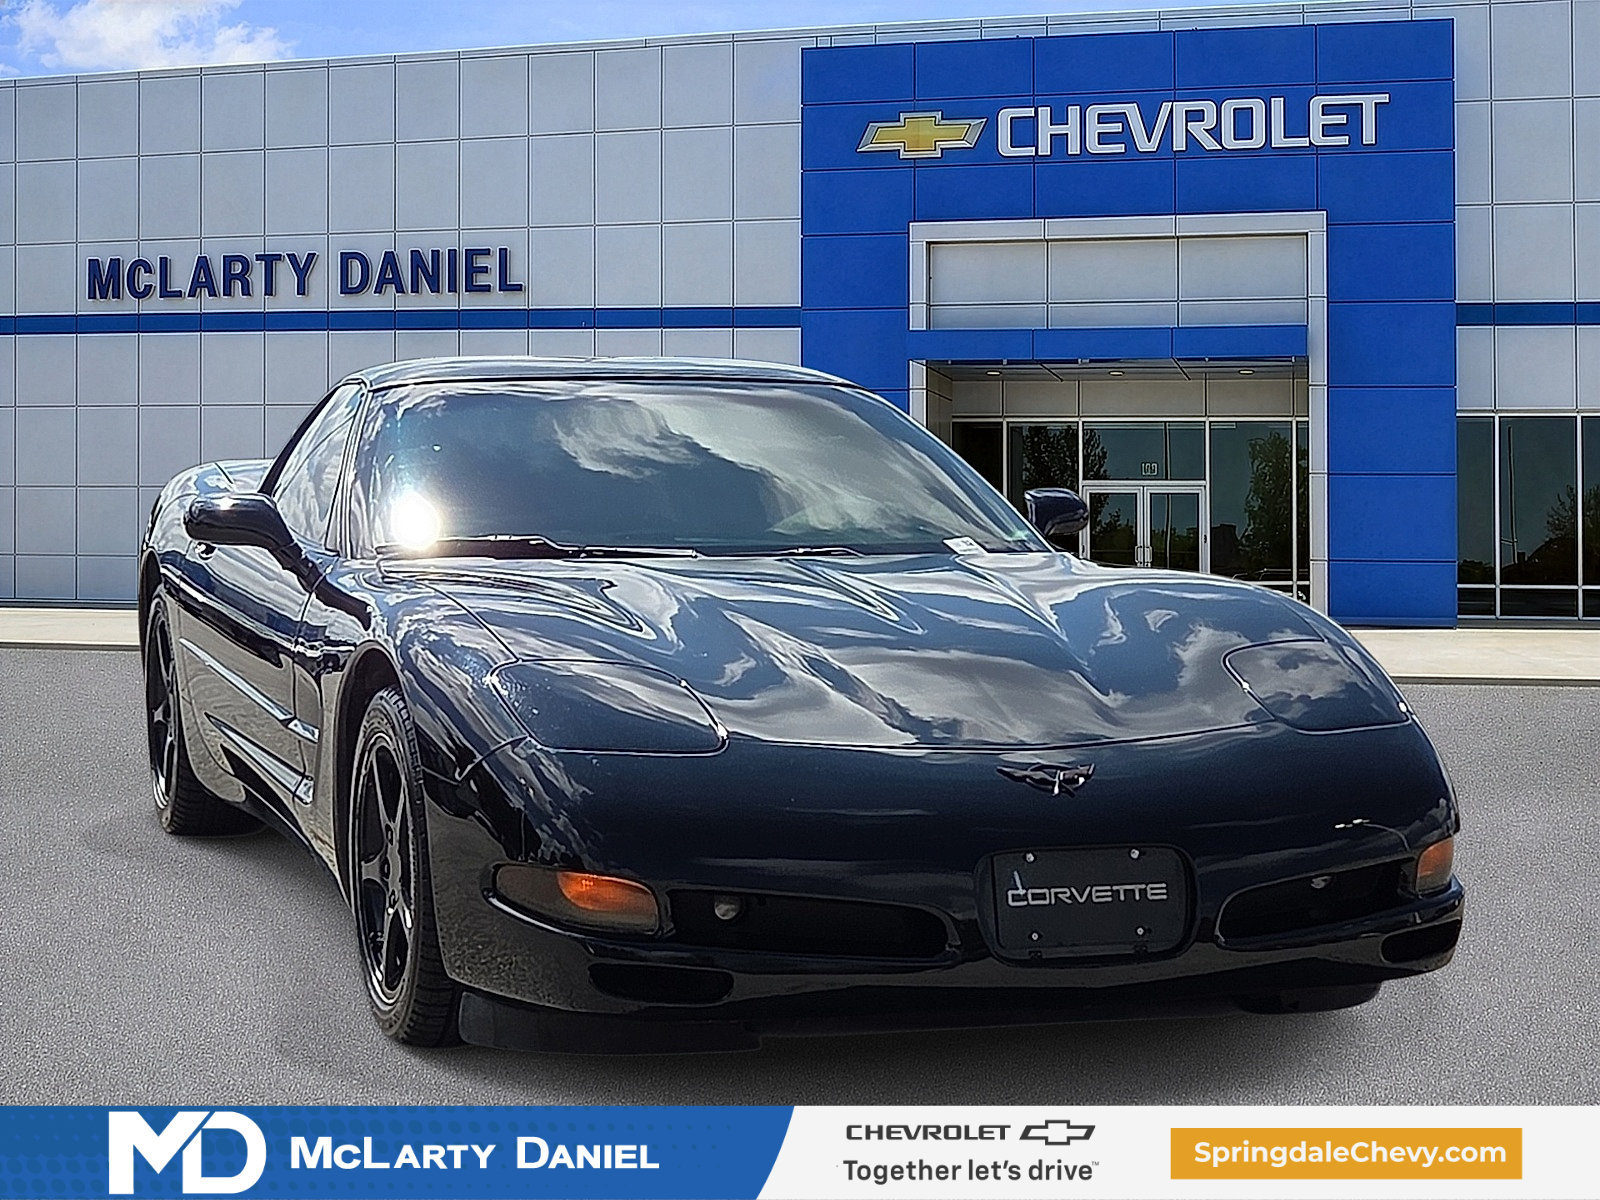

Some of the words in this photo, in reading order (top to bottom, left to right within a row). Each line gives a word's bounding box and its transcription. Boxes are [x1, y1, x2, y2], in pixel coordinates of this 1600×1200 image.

[998, 93, 1390, 157] CHEVROLET
[339, 247, 524, 295] DANIEL
[1007, 883, 1168, 906] CORVETTE
